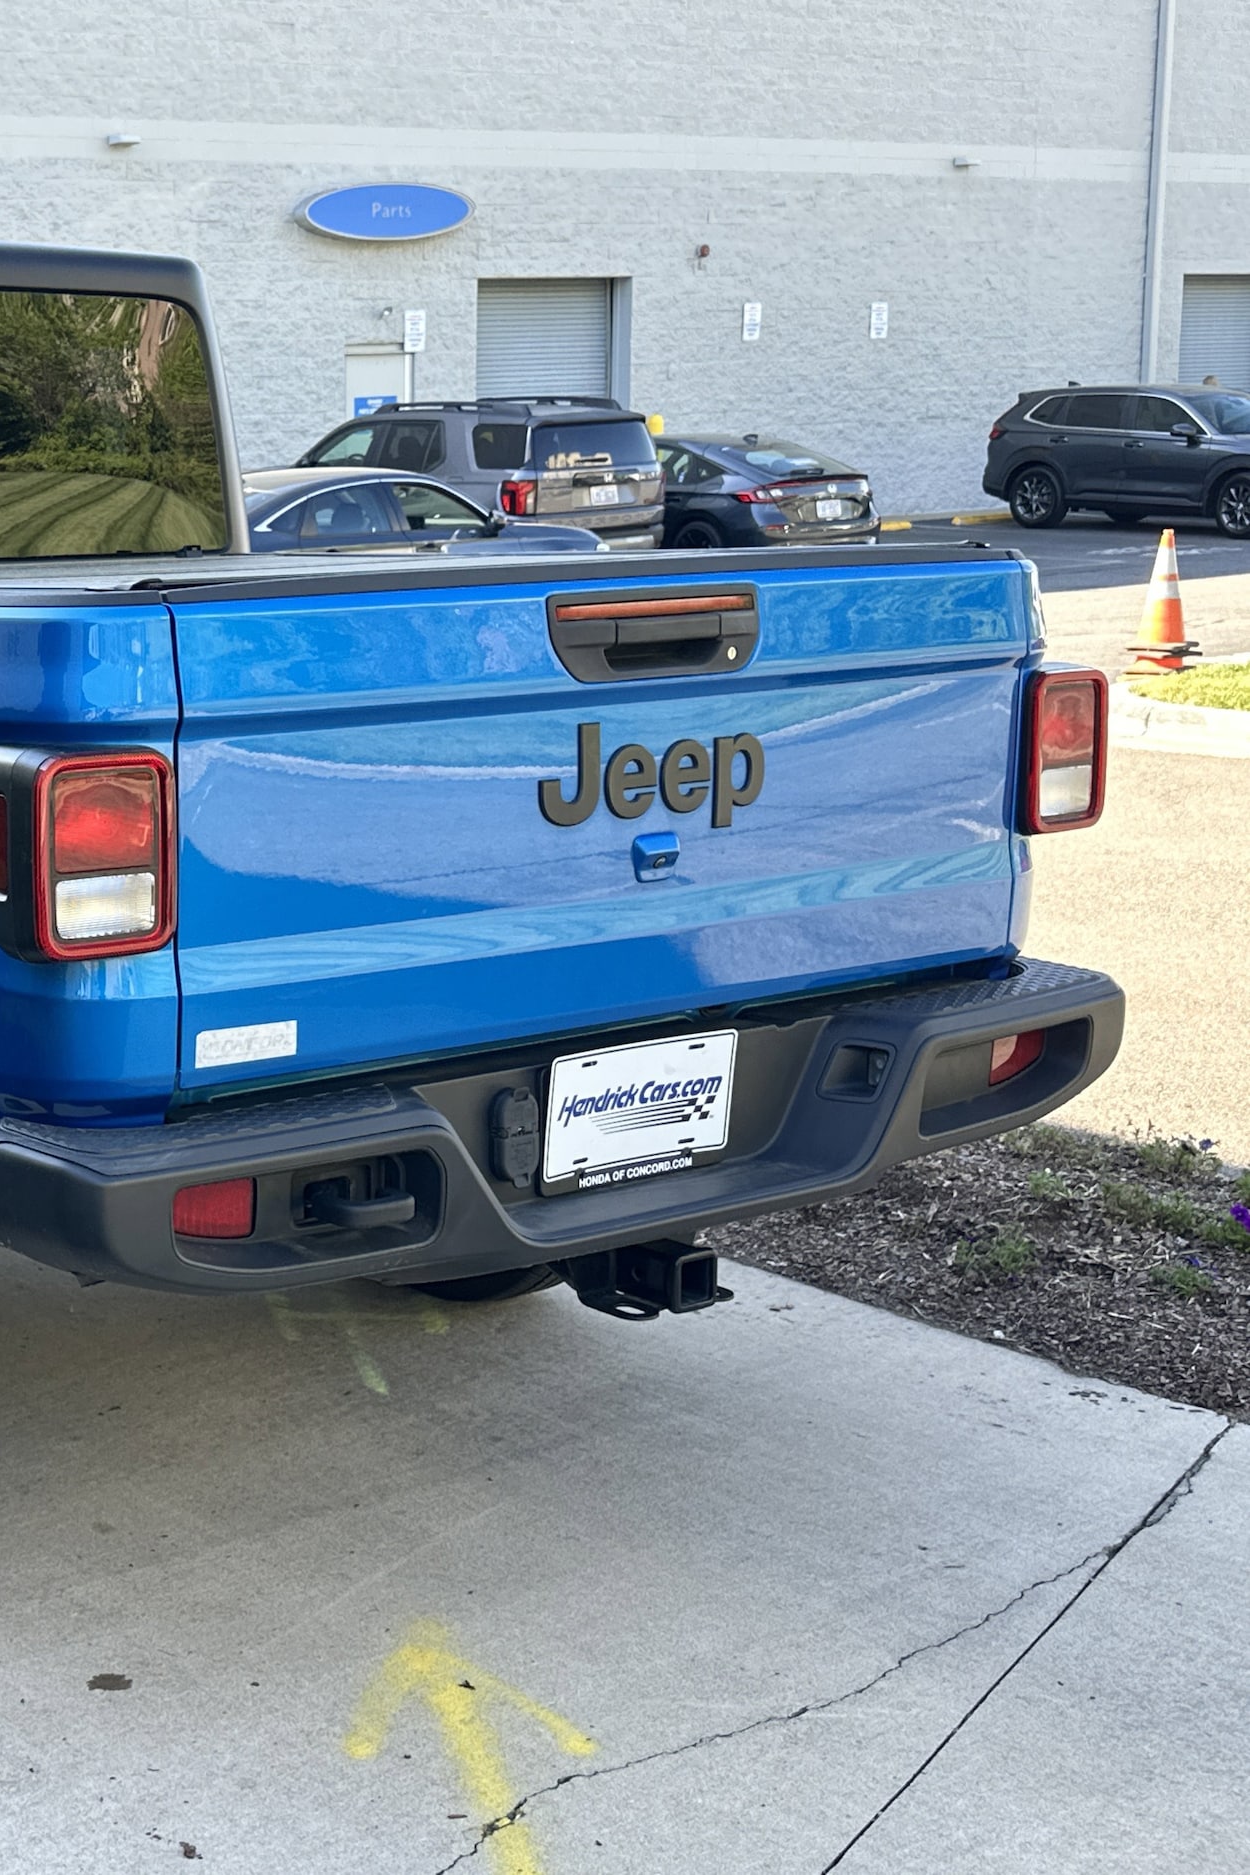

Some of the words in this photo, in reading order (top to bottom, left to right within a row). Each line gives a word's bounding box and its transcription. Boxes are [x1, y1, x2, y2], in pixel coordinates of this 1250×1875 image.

[372, 202, 411, 218] Parts
[538, 722, 765, 828] Jeep
[579, 1173, 611, 1188] HONDA
[613, 1169, 625, 1182] OF
[626, 1157, 692, 1178] CONCORD.COM
